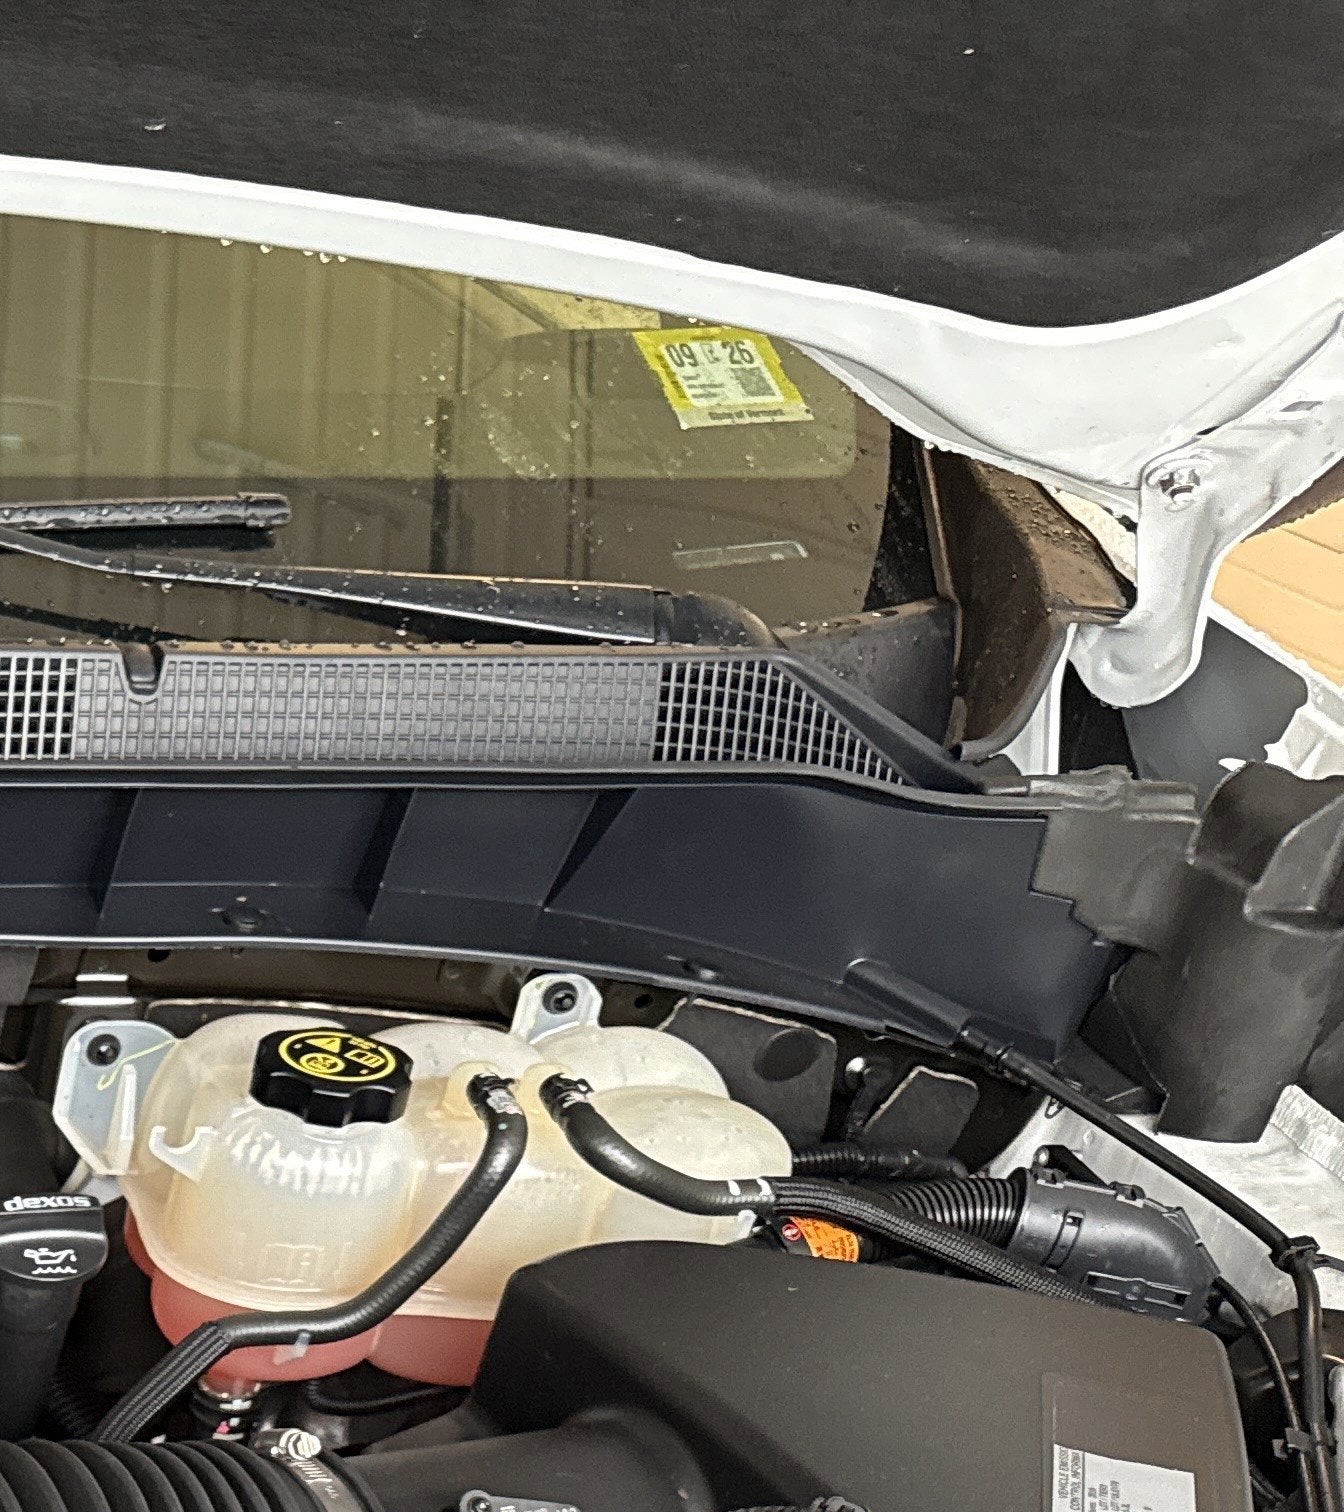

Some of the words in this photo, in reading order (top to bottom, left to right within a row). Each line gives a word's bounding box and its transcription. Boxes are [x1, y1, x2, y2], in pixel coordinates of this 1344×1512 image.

[664, 343, 699, 368] 09
[722, 340, 755, 365] 26
[3, 1195, 91, 1212] dexos
